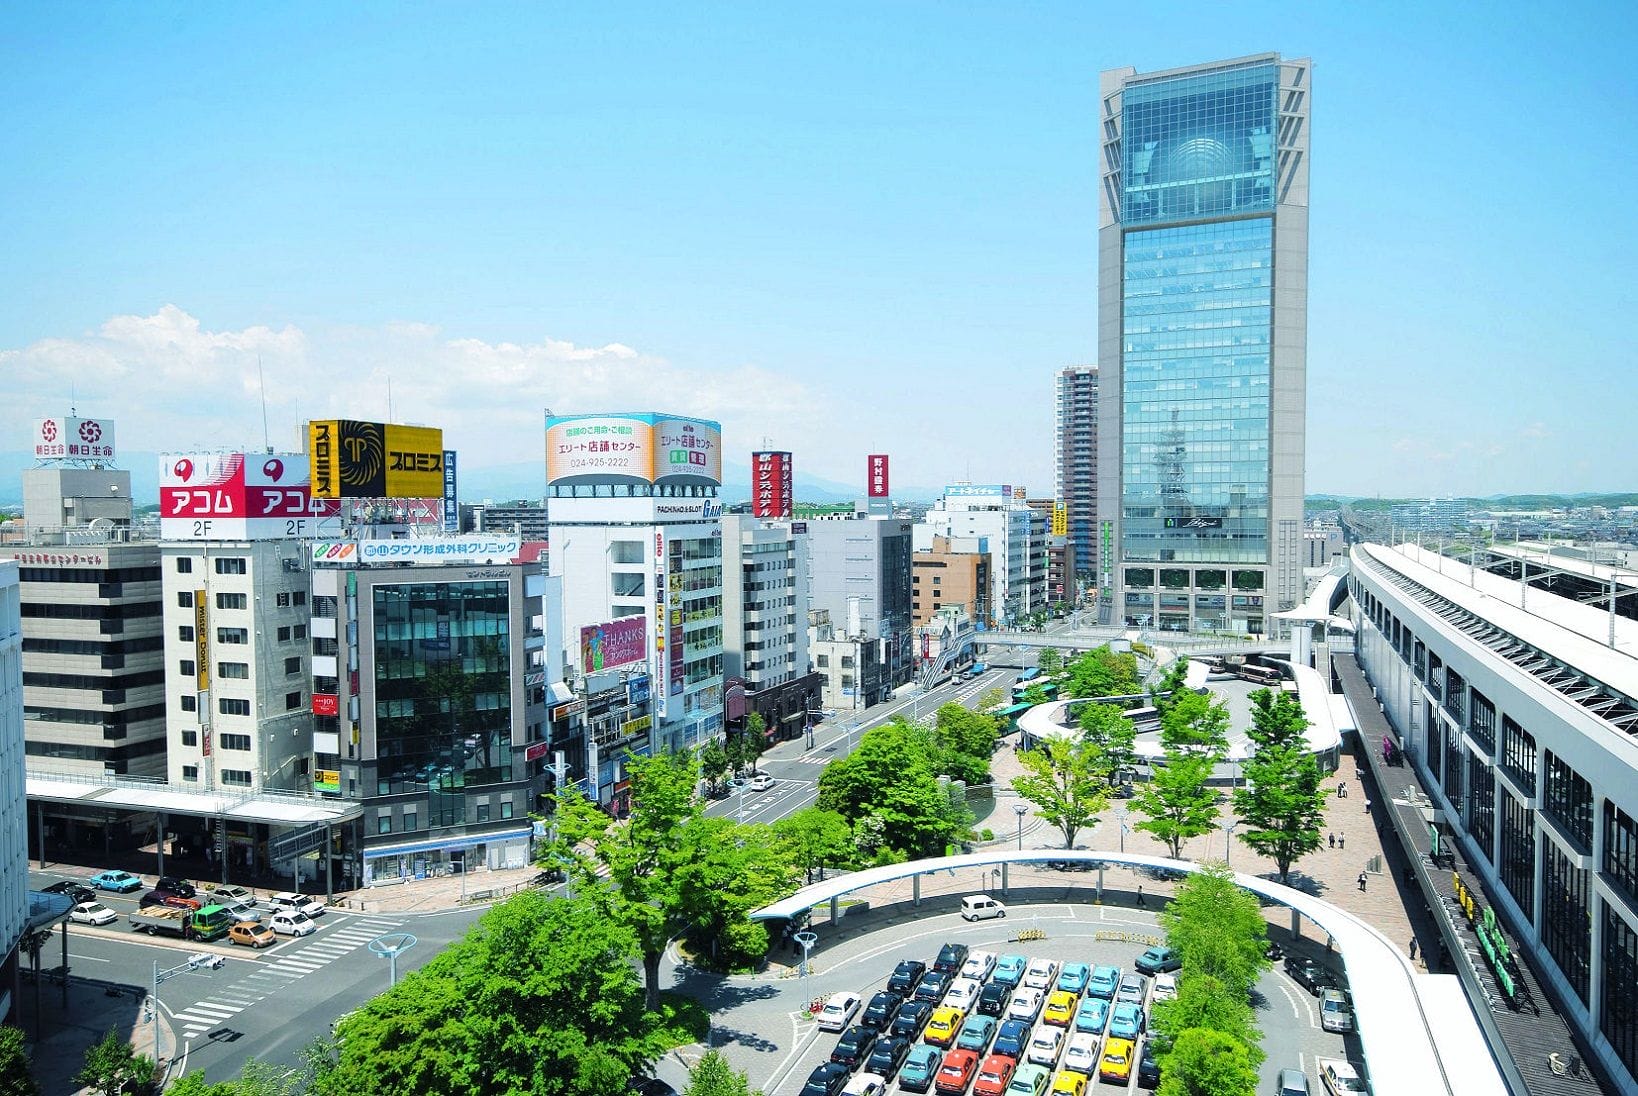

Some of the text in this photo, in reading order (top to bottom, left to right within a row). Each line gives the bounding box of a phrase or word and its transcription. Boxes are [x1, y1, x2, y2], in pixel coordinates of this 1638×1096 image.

[69, 444, 113, 457] 朝日生命
[558, 440, 641, 454] エリート店舗センター
[316, 425, 331, 492] プロミス
[389, 451, 442, 472] プロミス
[570, 458, 629, 468] 024-925-2222
[759, 454, 773, 517] 郡山シティホテル
[172, 490, 233, 515] アコム
[263, 490, 326, 515] アコム
[193, 520, 212, 536] 2F
[286, 520, 305, 536] 2F
[603, 628, 644, 649] THANKS
